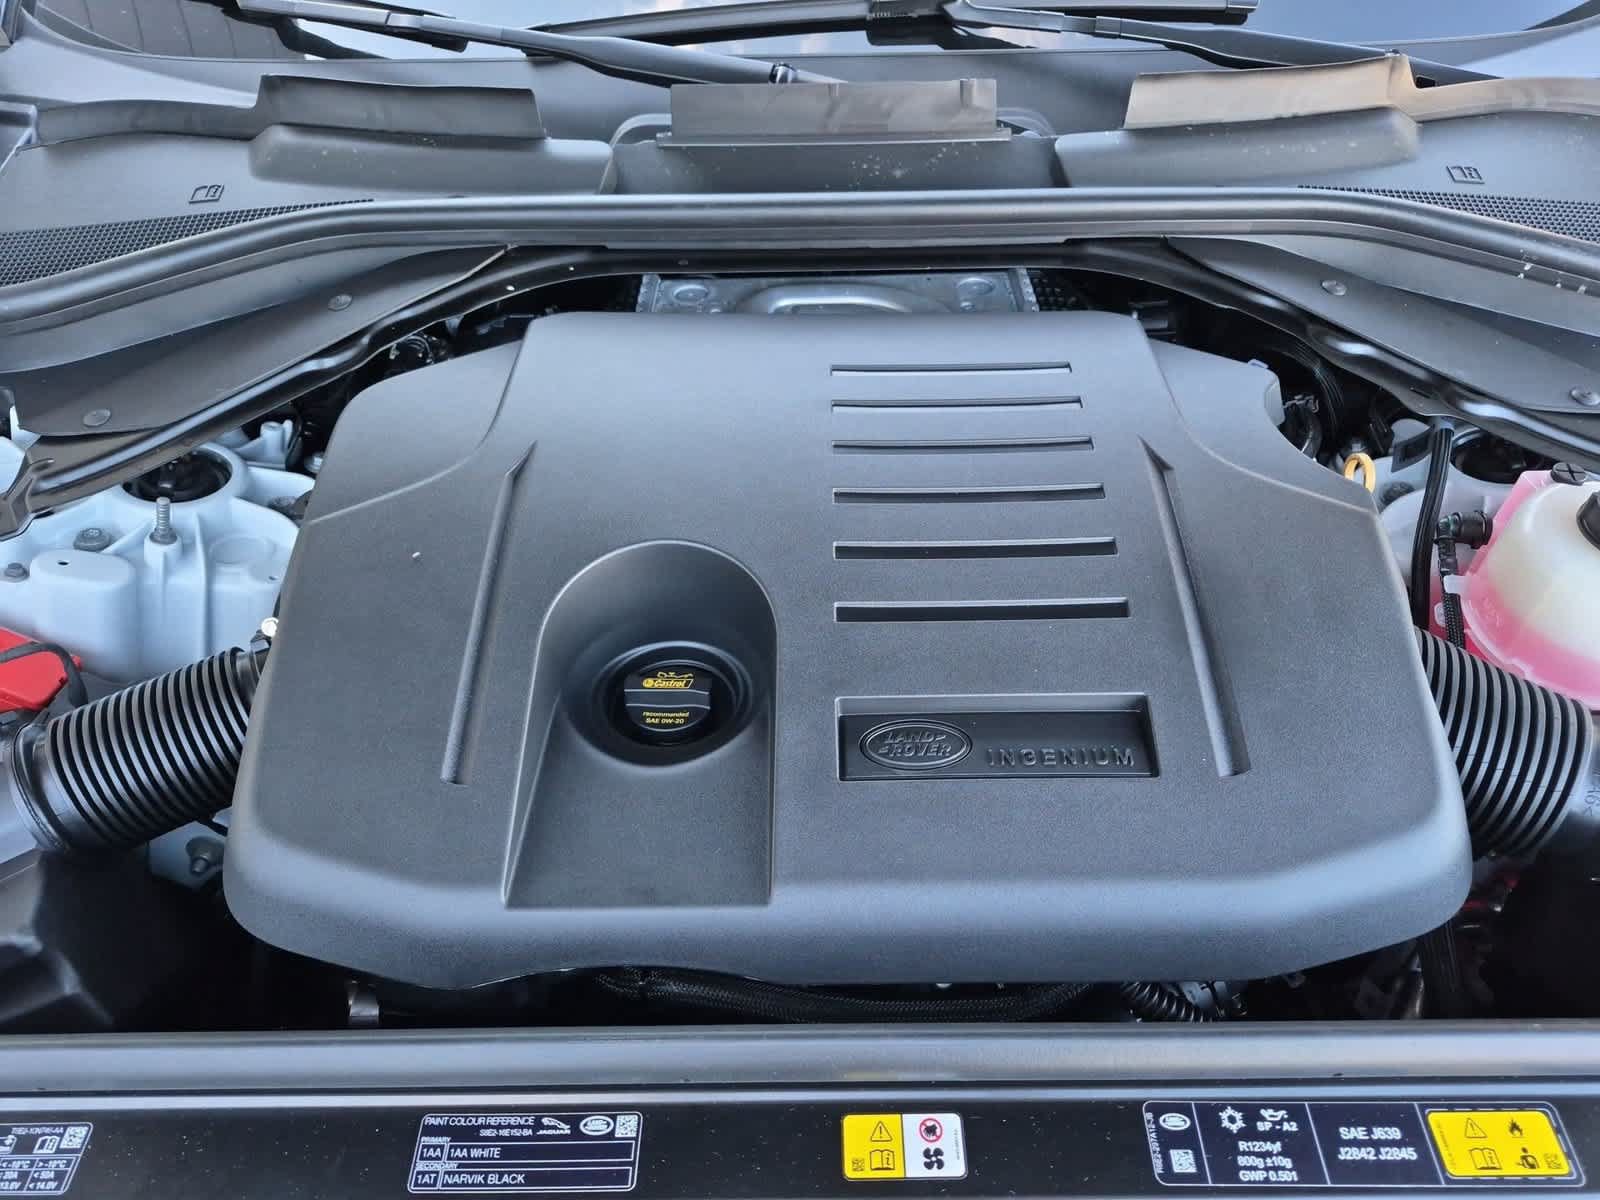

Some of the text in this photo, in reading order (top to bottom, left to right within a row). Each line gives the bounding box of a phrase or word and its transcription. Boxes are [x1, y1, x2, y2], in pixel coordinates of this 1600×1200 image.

[654, 679, 687, 688] Castrol
[987, 748, 1136, 767] INGENIUM
[424, 1116, 535, 1126] PAINT COLOUR REFERENCE
[1282, 1121, 1299, 1131] A2
[1339, 1127, 1402, 1140] SAE J639
[422, 1148, 441, 1158] 1AA
[450, 1147, 501, 1158] 1AA WHITE
[1338, 1147, 1418, 1160] J2842 J2845
[417, 1174, 437, 1184] 1AT
[443, 1174, 526, 1184] NARVIK BLACK
[1239, 1170, 1298, 1181] GWP 0.501
